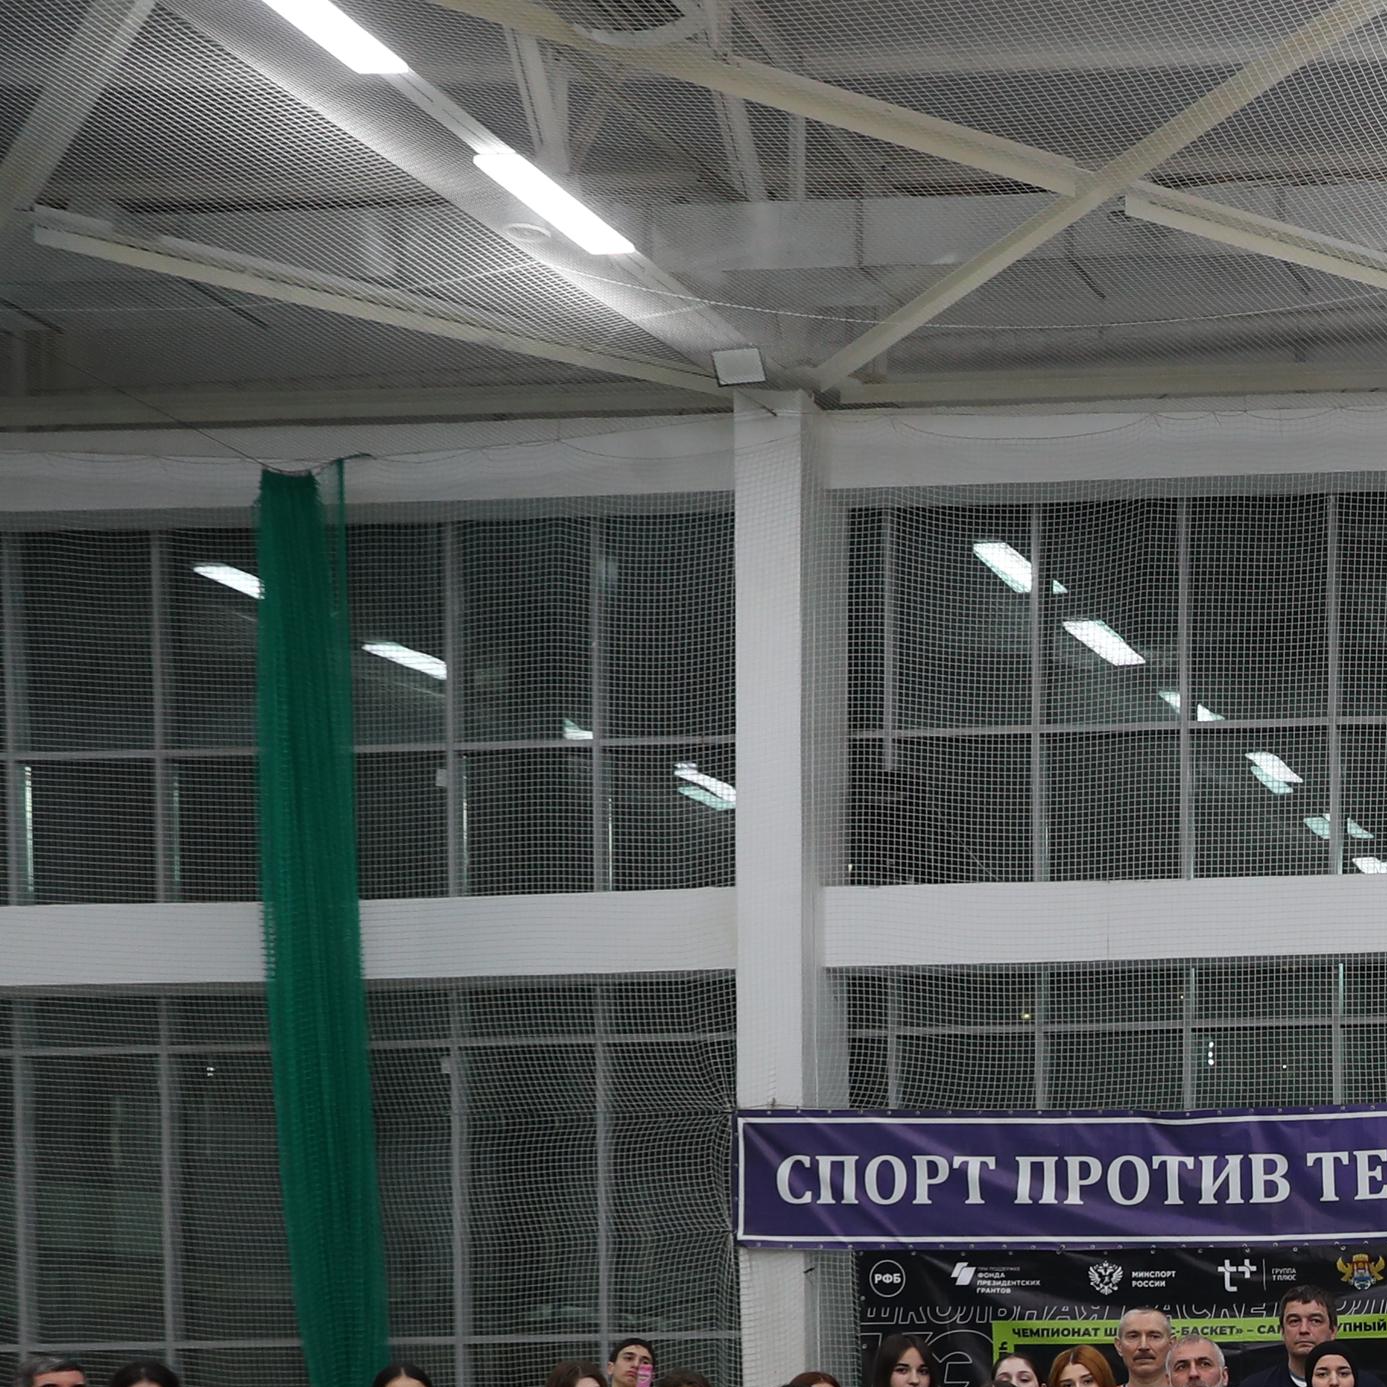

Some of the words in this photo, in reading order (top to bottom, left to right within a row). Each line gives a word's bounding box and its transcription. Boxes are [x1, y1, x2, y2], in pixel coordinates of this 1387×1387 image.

[776, 1153, 996, 1206] СПОРТ
[1015, 1150, 1292, 1207] ПРОТИВ
[874, 1272, 902, 1286] РФБ
[977, 1271, 1006, 1279] ФОНДА
[1131, 1269, 1177, 1280] МИНСПОРТ
[976, 1279, 1041, 1287] ПРЕЗИДЕНТСКИХ
[1131, 1279, 1167, 1288] РОССИИ
[976, 1287, 1012, 1295] ГРАНТОВ
[1012, 1326, 1100, 1339] ЧЕМПИОНАТ
